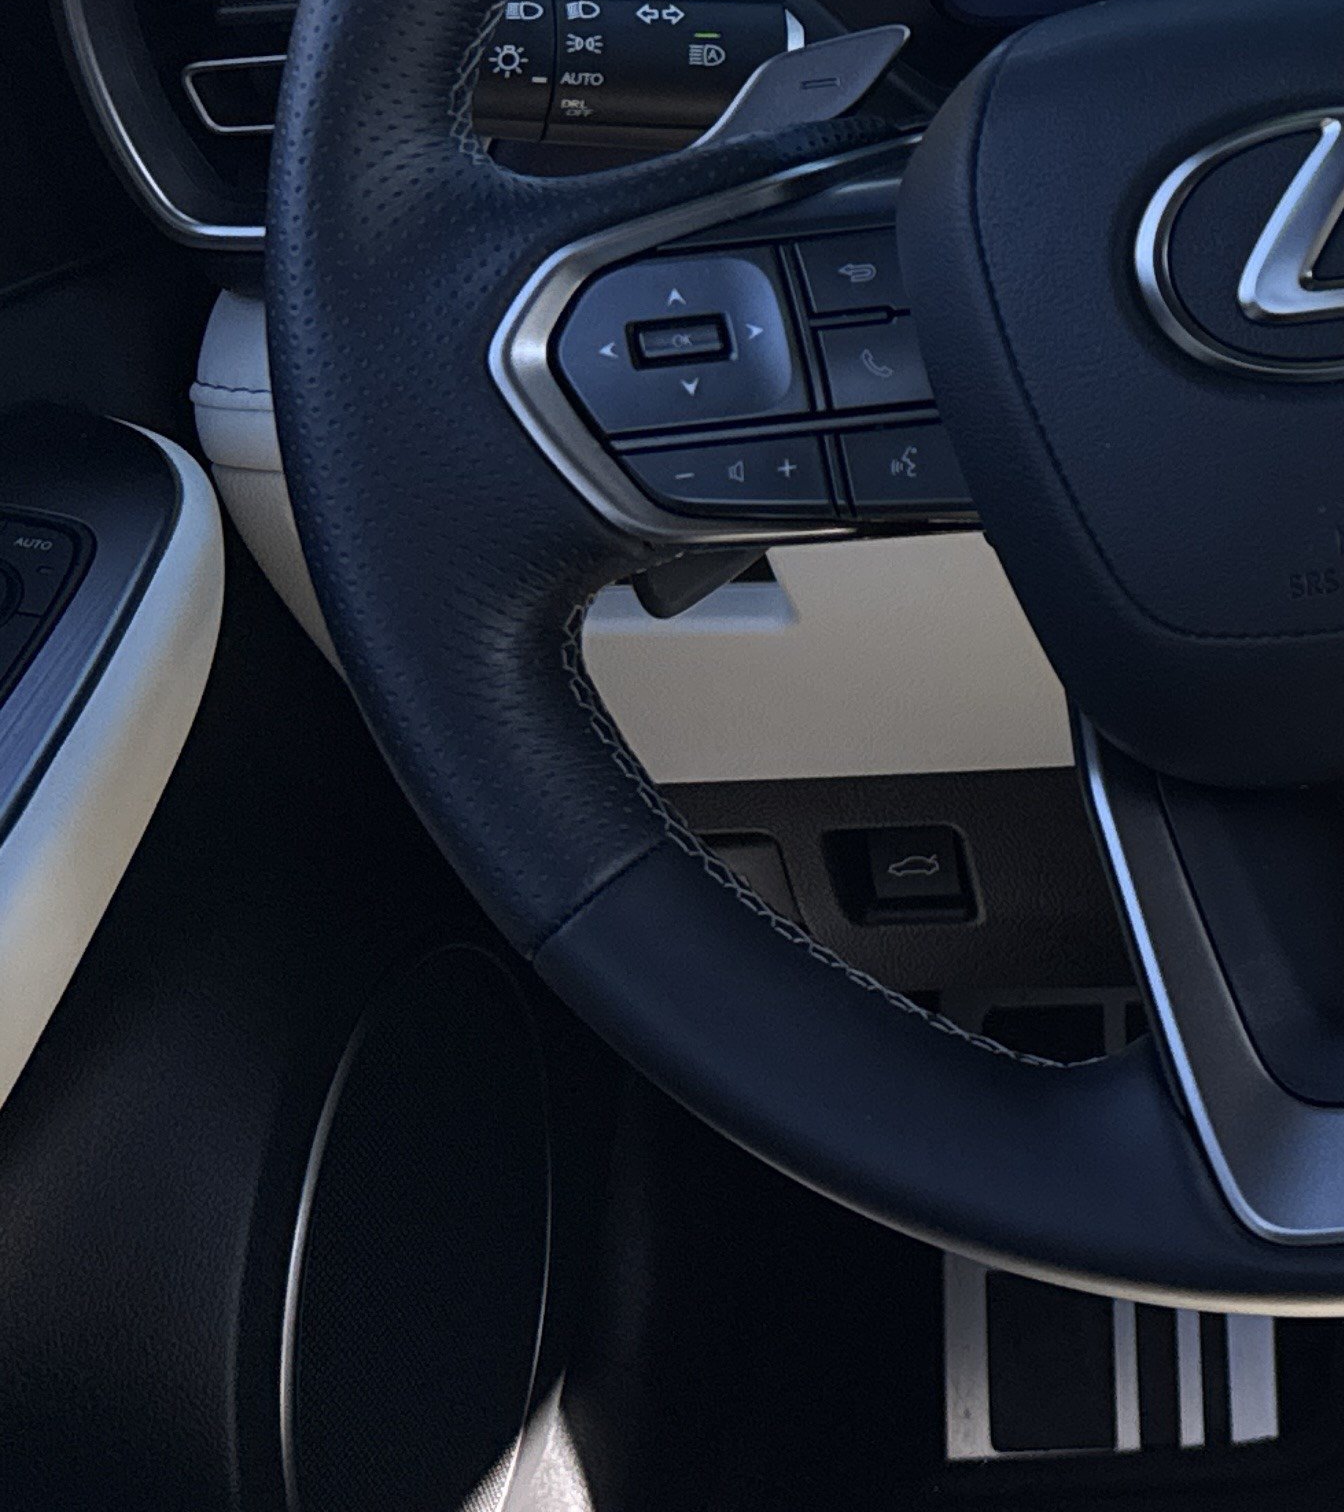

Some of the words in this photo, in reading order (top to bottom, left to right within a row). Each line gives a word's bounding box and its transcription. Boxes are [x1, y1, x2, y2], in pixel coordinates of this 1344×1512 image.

[560, 71, 604, 86] AUTO
[671, 333, 693, 348] OK
[14, 537, 53, 551] AUTO
